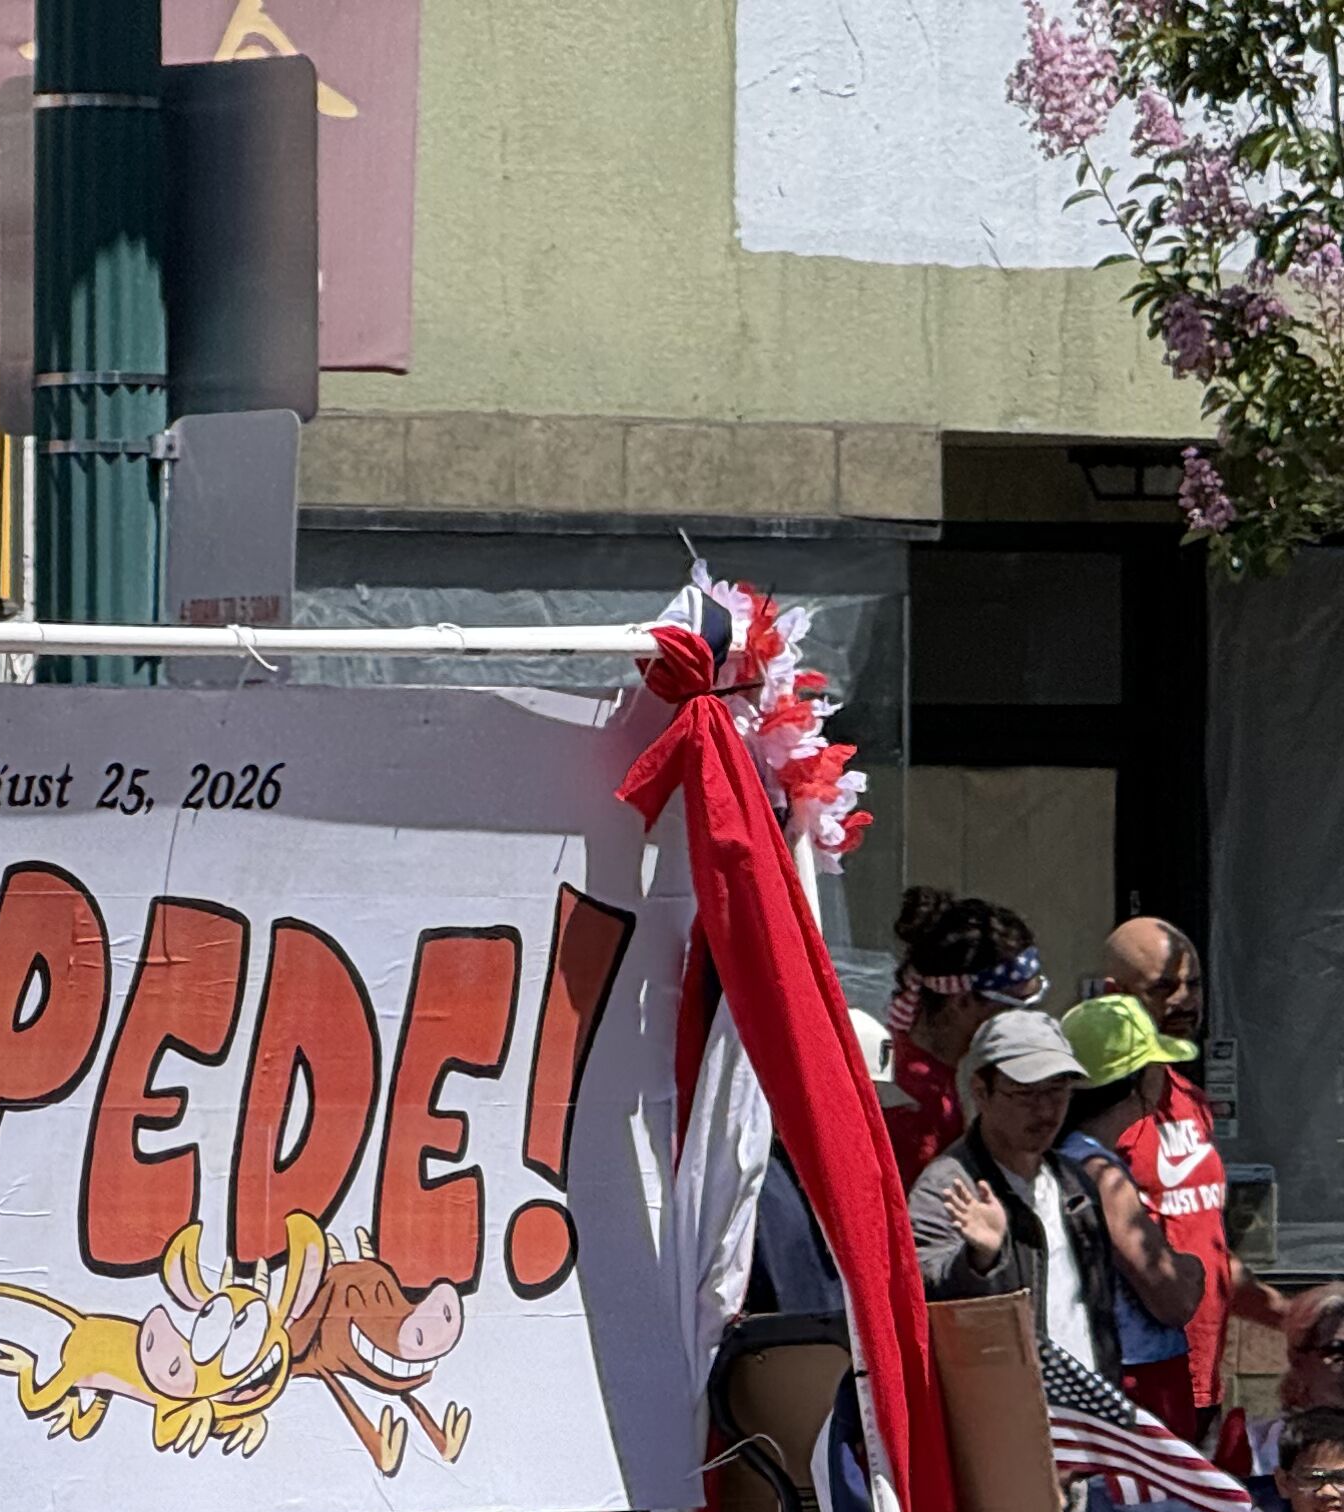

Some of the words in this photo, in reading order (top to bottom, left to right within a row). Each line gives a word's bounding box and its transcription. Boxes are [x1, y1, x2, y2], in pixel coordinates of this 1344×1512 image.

[97, 762, 156, 816] 25,
[181, 761, 287, 812] 2026
[1160, 1188, 1199, 1215] JUST
